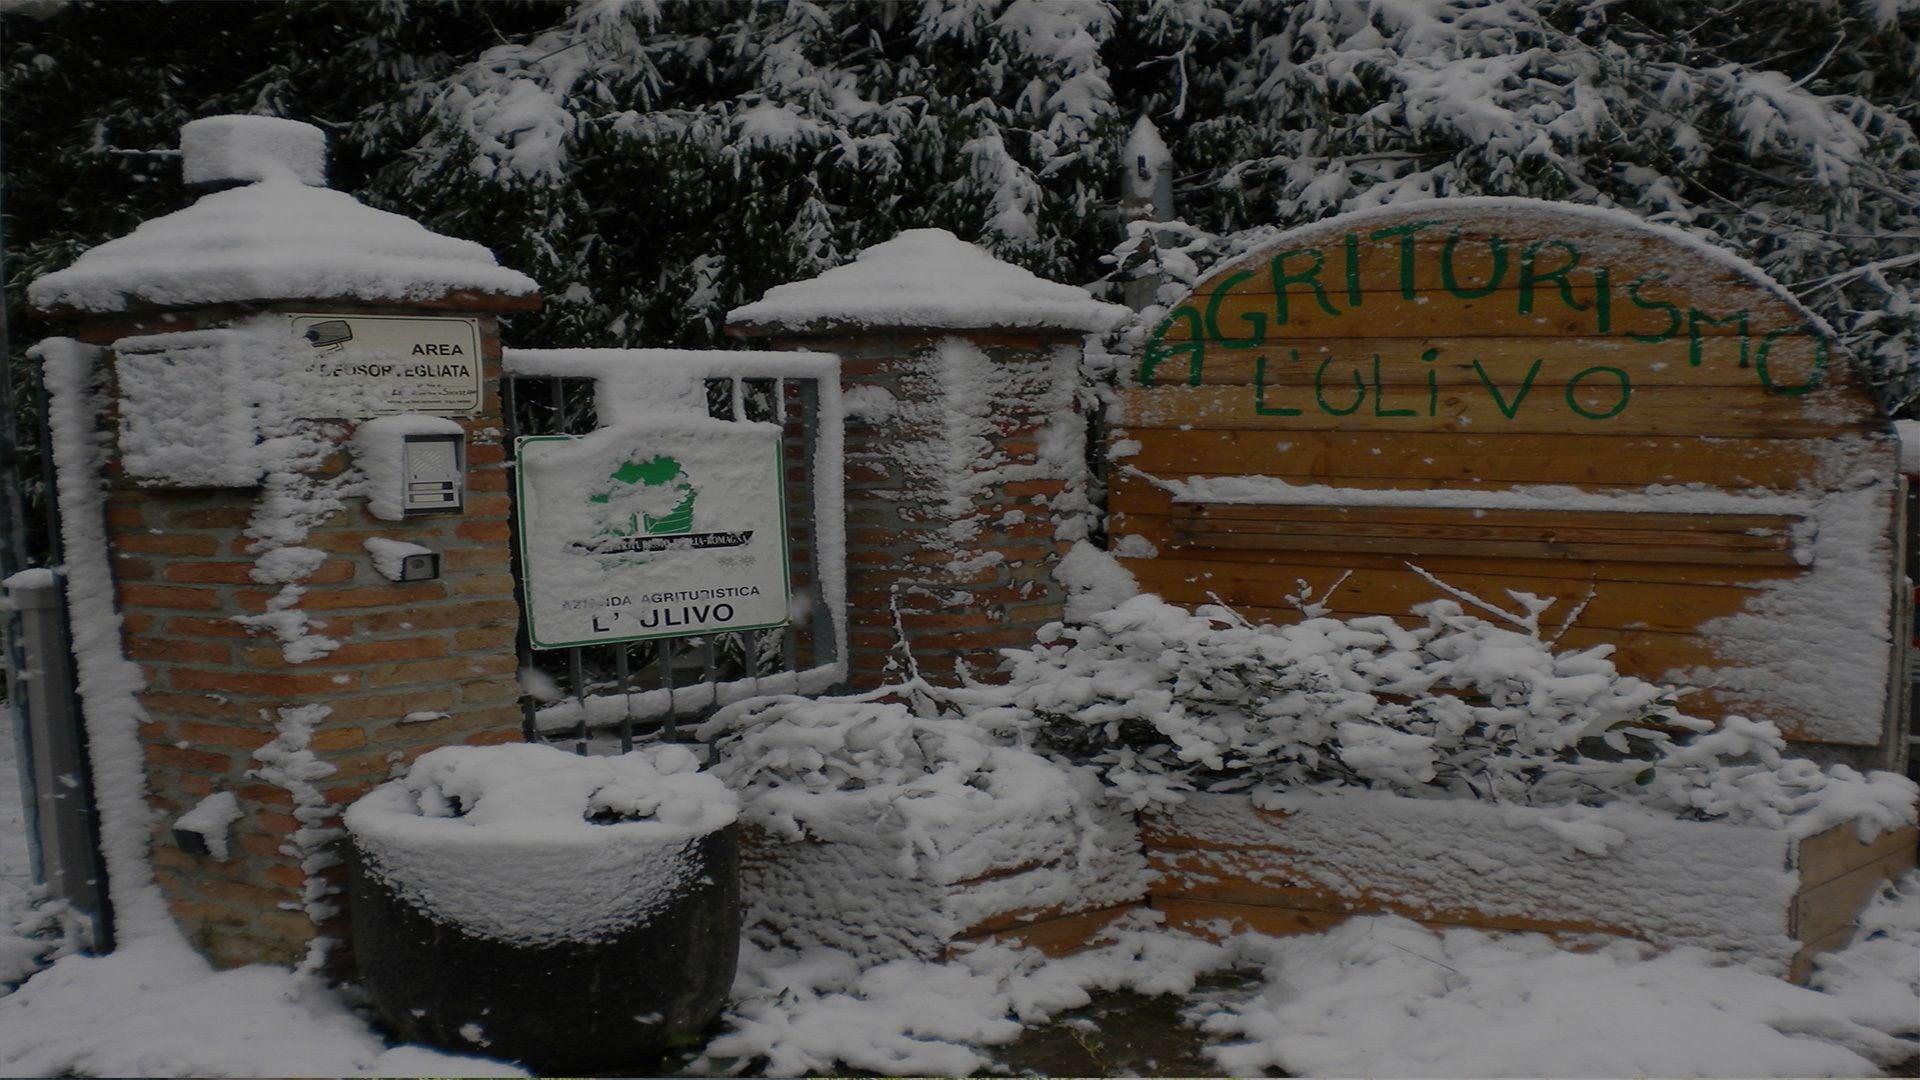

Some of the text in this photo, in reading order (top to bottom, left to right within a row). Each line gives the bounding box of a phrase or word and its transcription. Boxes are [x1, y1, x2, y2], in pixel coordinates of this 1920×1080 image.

[1138, 219, 1829, 396] AGRITURISMO
[411, 343, 464, 356] AREA
[640, 586, 761, 604] AGRITURISTICA
